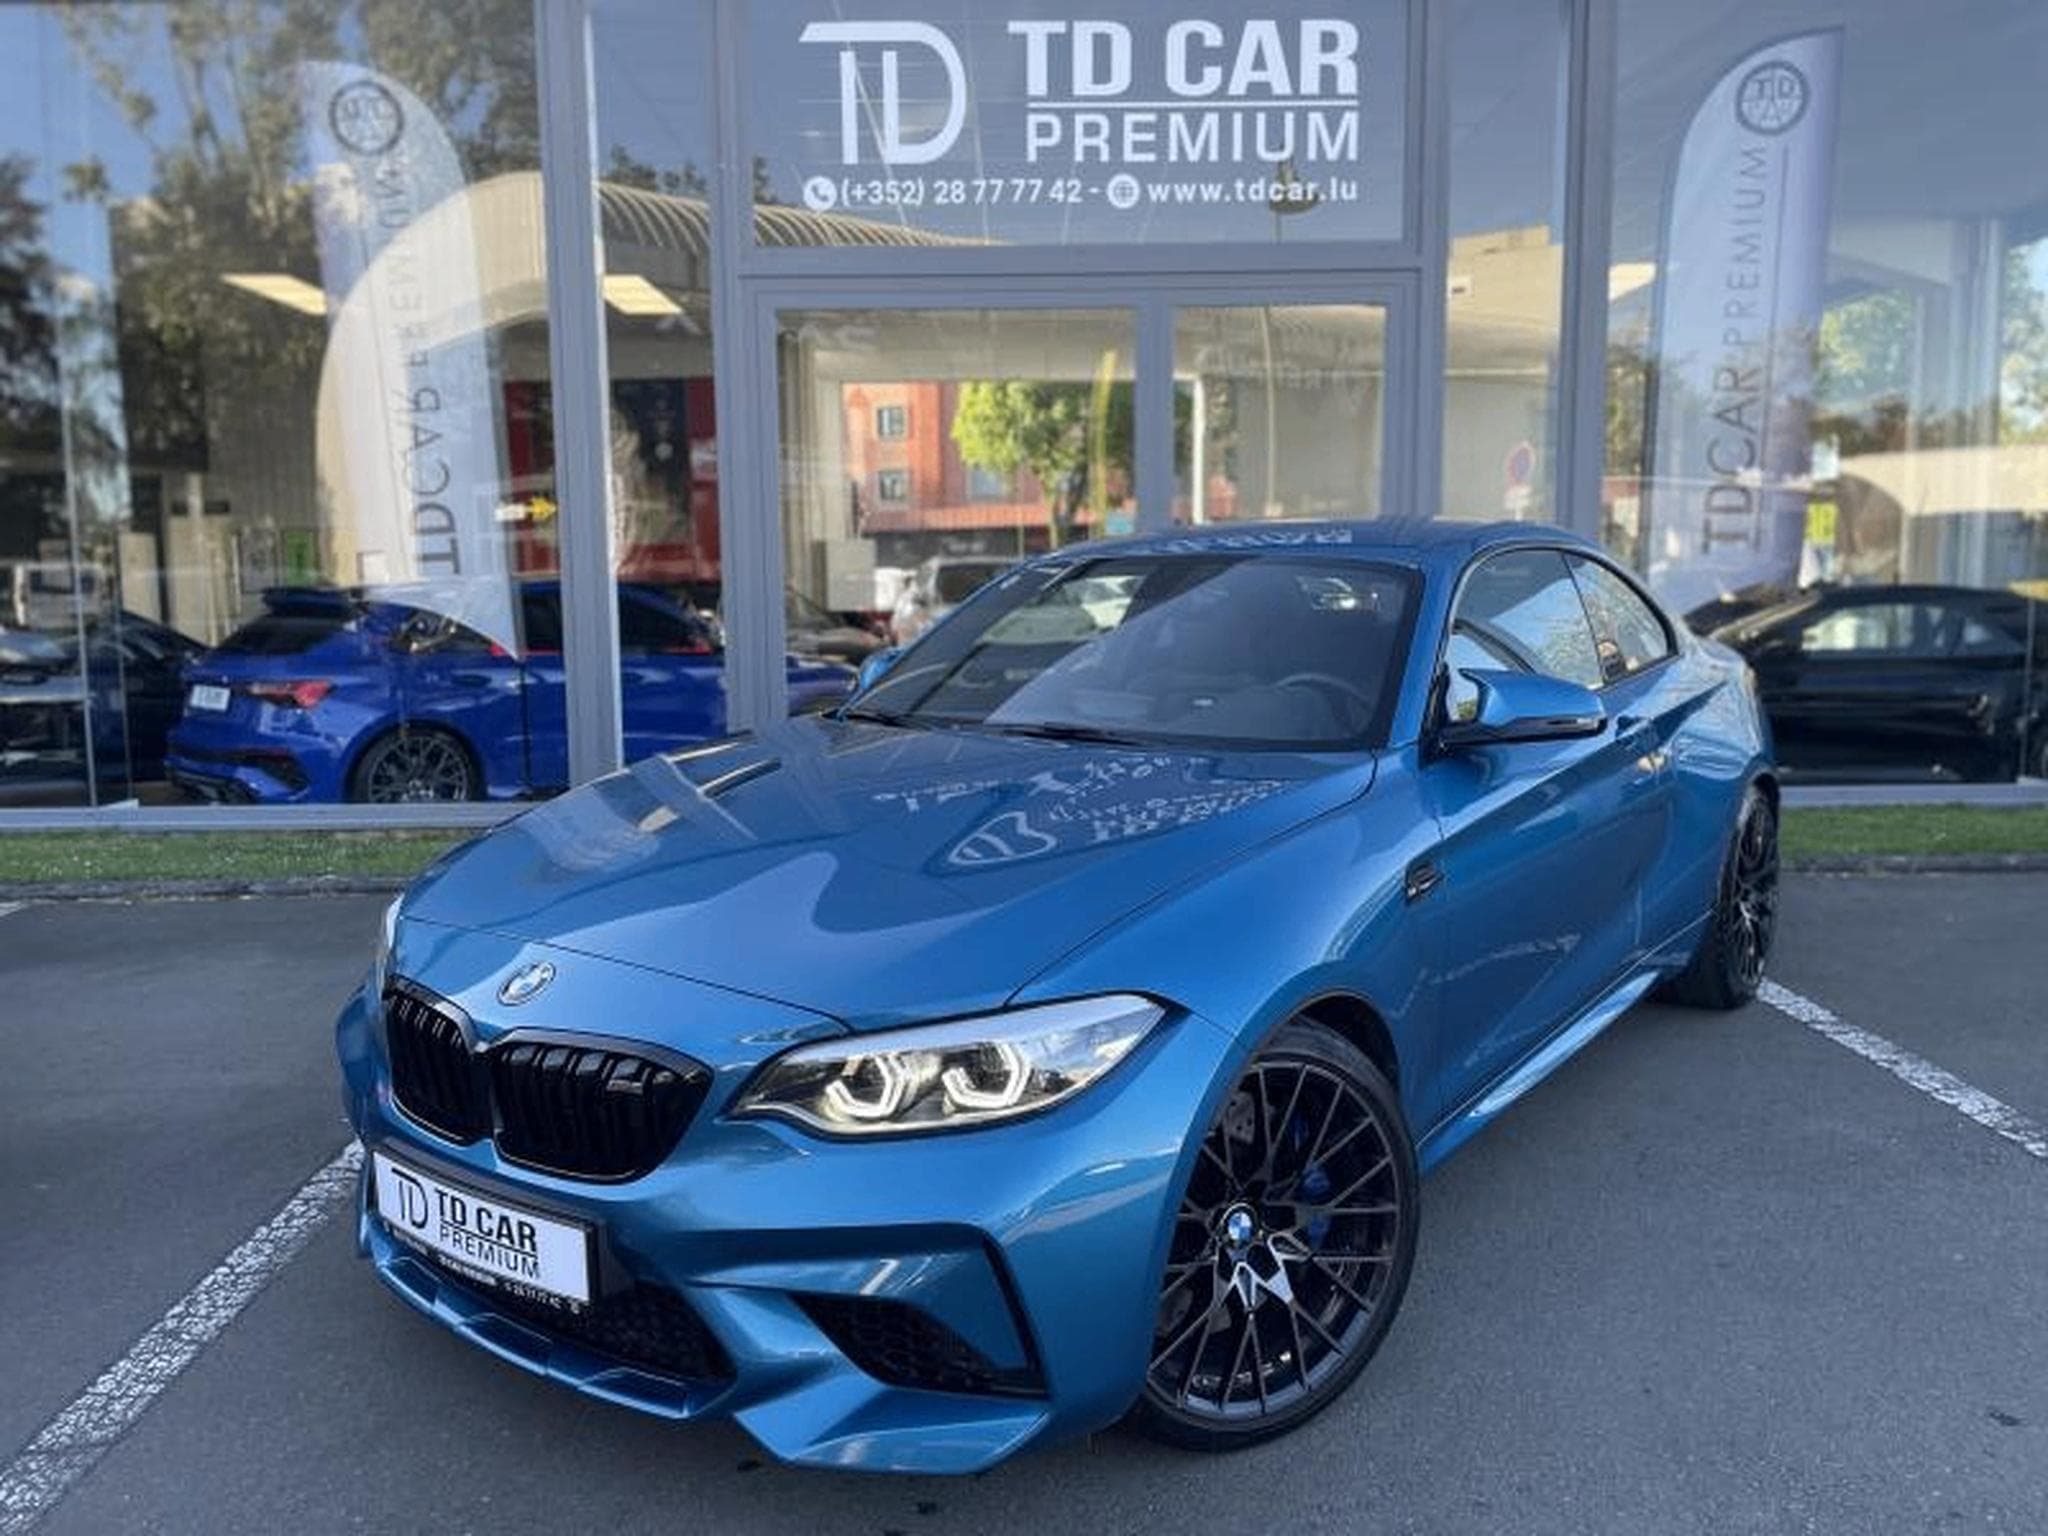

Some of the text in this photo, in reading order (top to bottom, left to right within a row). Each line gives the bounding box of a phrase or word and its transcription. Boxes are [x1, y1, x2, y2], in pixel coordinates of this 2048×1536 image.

[1007, 19, 1359, 97] TD CAR
[1026, 111, 1359, 163] PREMIUM
[841, 178, 924, 206] (+352)
[933, 180, 966, 204] 28
[971, 179, 1004, 204] 77
[1010, 179, 1043, 204] 77
[1049, 179, 1083, 203] 42
[1148, 177, 1358, 202] www.tdcar.lu
[1722, 146, 1767, 349] PREMIUM
[435, 1187, 467, 1227] TD
[476, 1207, 537, 1252] CAR
[439, 1223, 541, 1280] PREMIUM
